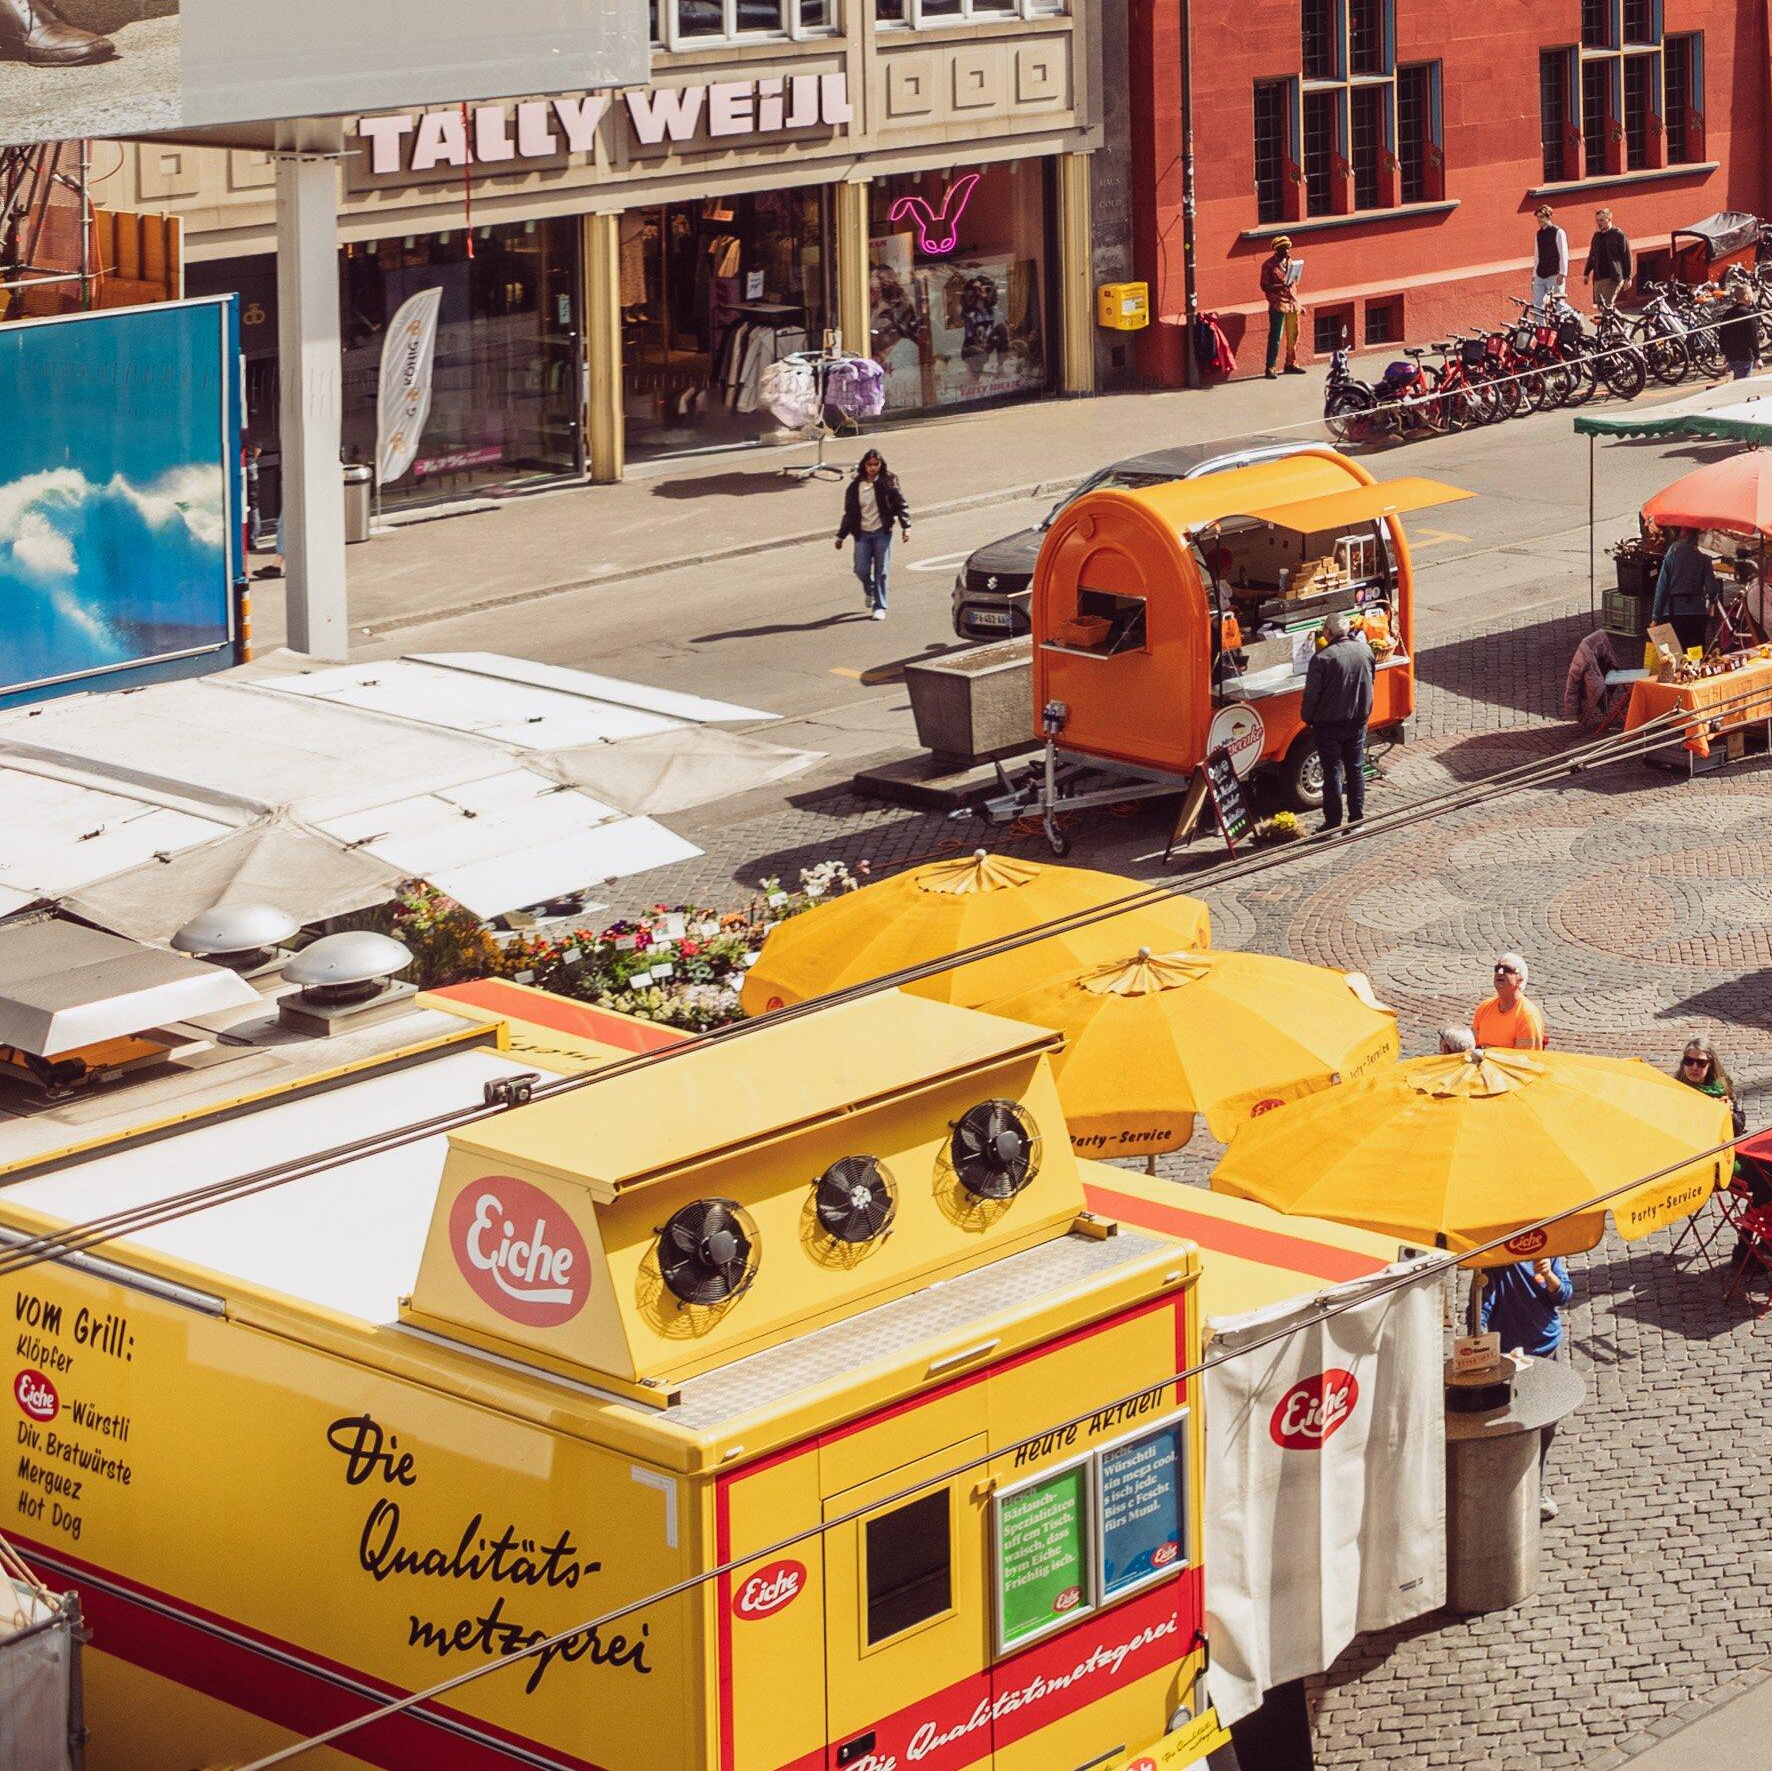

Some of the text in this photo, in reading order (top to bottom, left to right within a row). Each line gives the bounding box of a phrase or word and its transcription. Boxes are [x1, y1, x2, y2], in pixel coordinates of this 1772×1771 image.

[359, 95, 607, 174] TALLY
[466, 1193, 575, 1305] Eiche
[16, 1333, 74, 1374] Klöpfer
[73, 1307, 135, 1362] Grill:
[18, 1374, 131, 1443] Eiche -Würstli
[1280, 1381, 1349, 1438] Eiche
[17, 1420, 132, 1486] Div. Bratwürste
[326, 1413, 418, 1487] Die
[1103, 1450, 1179, 1492] sin mega cool.
[17, 1455, 83, 1501] Merguez
[1104, 1502, 1127, 1519] Biss
[1135, 1481, 1171, 1505] Fescht
[1111, 1484, 1134, 1503] isch
[1134, 1474, 1159, 1495] jede
[17, 1489, 83, 1540] Hot Dog
[1004, 1512, 1075, 1550] uff em Tisch,
[1045, 1527, 1070, 1545] dass
[1104, 1499, 1162, 1534] fürs Muul.
[359, 1497, 602, 1590] Qualitäts-
[1005, 1545, 1062, 1579] bym Eiche
[1051, 1552, 1077, 1571] isch.
[1155, 1543, 1178, 1565] Eiche
[741, 1569, 799, 1612] Eiche
[1056, 1589, 1081, 1610] Eiche
[408, 1596, 652, 1695] metzgerei
[906, 1611, 1179, 1762] Qualitätsmetzgerei
